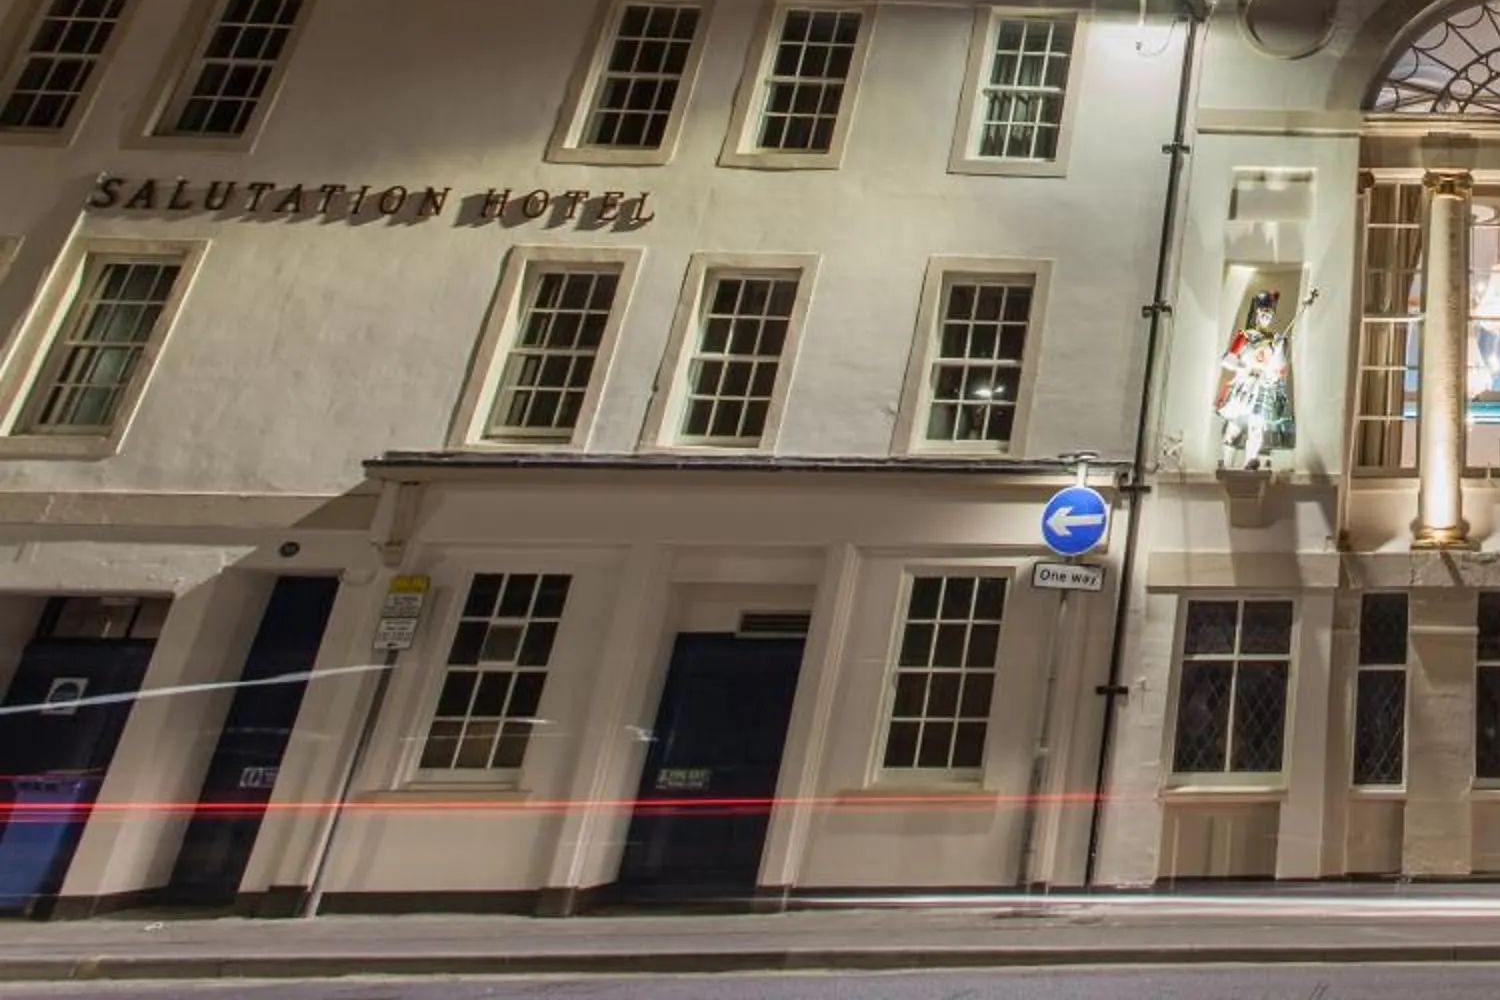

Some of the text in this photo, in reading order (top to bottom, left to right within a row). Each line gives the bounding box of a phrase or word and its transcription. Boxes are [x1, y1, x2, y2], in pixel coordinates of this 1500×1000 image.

[89, 177, 656, 223] SALUTATION HOTEL
[1039, 568, 1099, 587] One way
